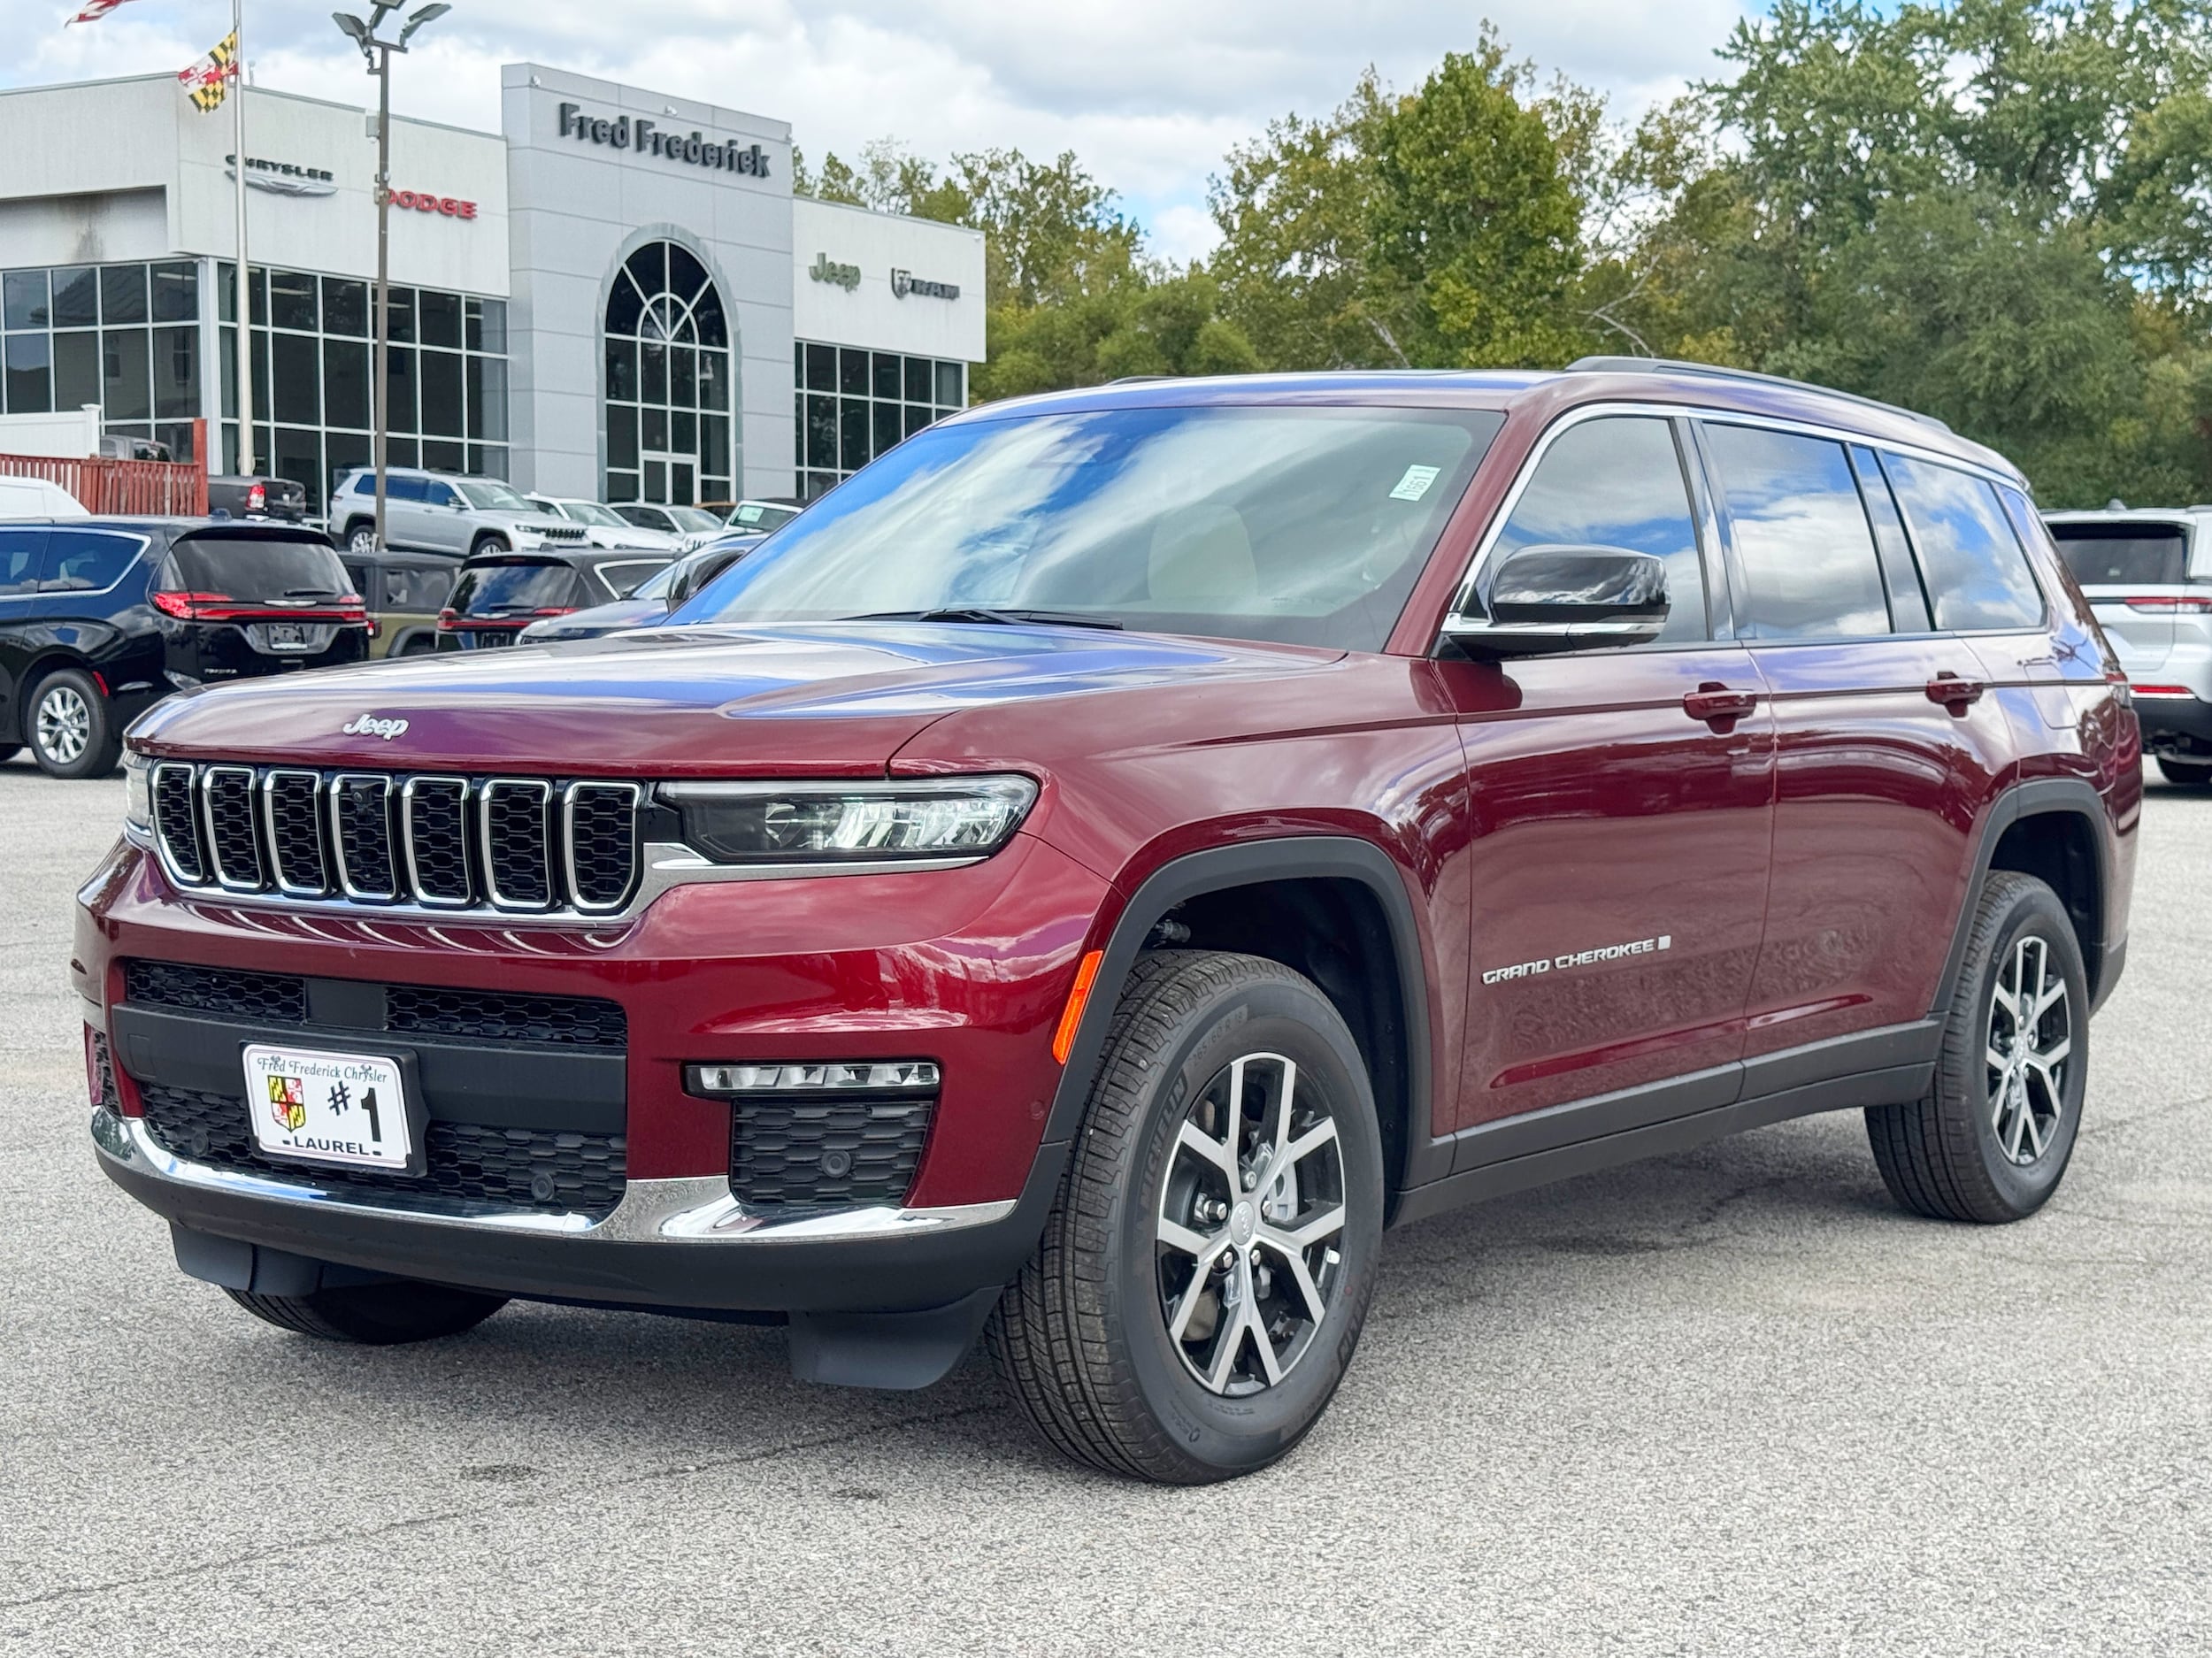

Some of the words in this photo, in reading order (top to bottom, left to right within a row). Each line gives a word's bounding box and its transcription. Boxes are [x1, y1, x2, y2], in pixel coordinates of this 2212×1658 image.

[560, 103, 630, 149] Fred
[635, 119, 771, 178] Frederick
[226, 154, 334, 180] CHRYSLER
[809, 252, 861, 293] Jeep
[910, 279, 960, 300] RAM
[342, 713, 410, 741] Jeep
[1482, 959, 1551, 986] GRAND
[1554, 938, 1655, 970] CHEROKEE
[257, 1056, 286, 1072] Fred
[288, 1060, 342, 1078] Frederick
[344, 1066, 388, 1084] Chrysler
[1140, 1073, 1187, 1210] MICHELIN
